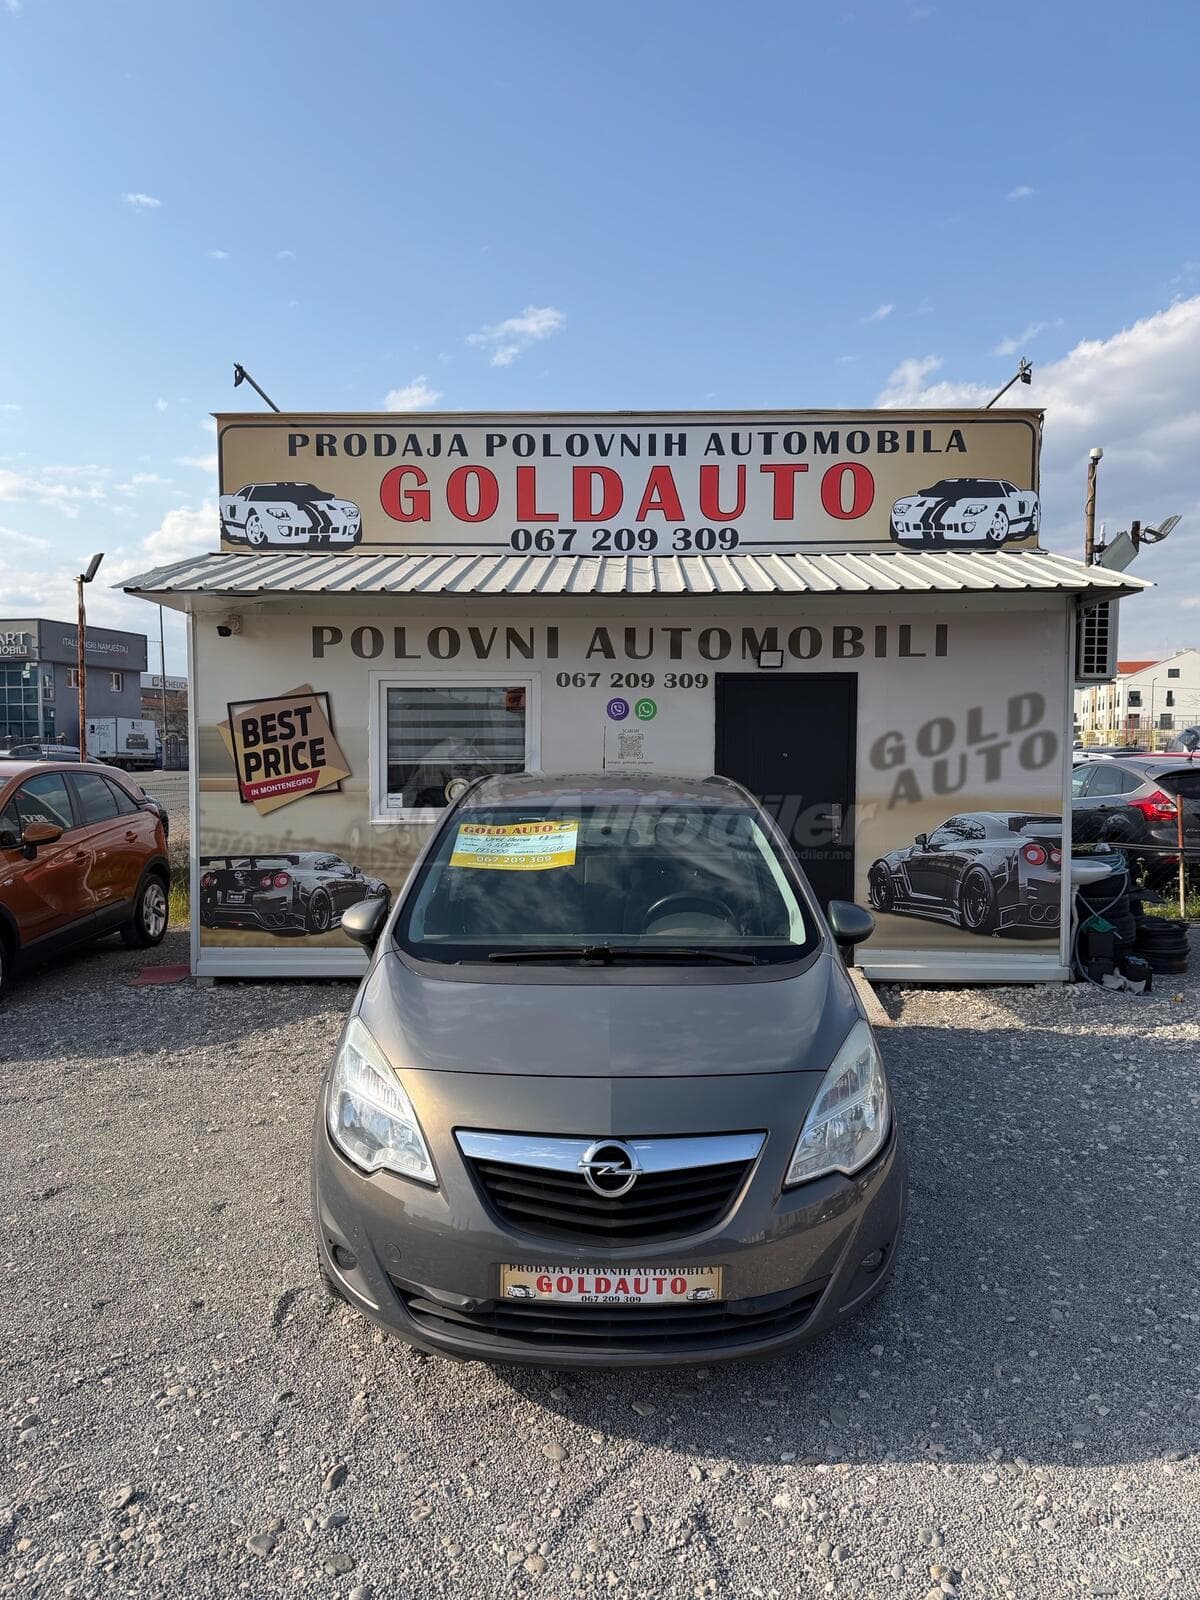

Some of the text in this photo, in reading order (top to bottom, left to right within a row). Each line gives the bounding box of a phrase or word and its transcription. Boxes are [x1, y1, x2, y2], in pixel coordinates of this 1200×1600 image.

[287, 429, 968, 458] PRODAJA POLOVNIH AUTOMOBILA
[379, 462, 875, 523] GOLDAUTO
[510, 527, 739, 552] 067 209 309
[0, 646, 27, 655] OBILI
[311, 623, 949, 661] POLOVNI AUTOMOBILI
[555, 671, 709, 689] 067 209 309
[241, 705, 313, 749] BEST
[868, 690, 1048, 772] GOLD
[243, 736, 327, 783] PRICE
[885, 729, 1060, 812] AUTO
[250, 776, 313, 796] IN MONTENEGRO
[463, 824, 553, 835] GOLD AUTO
[529, 855, 553, 863] 309
[509, 1264, 715, 1276] PRODAJA POLOVNIH AUTOMOBILA
[536, 1275, 688, 1295] GOLDAUTO
[581, 1295, 642, 1304] 067 209 309
